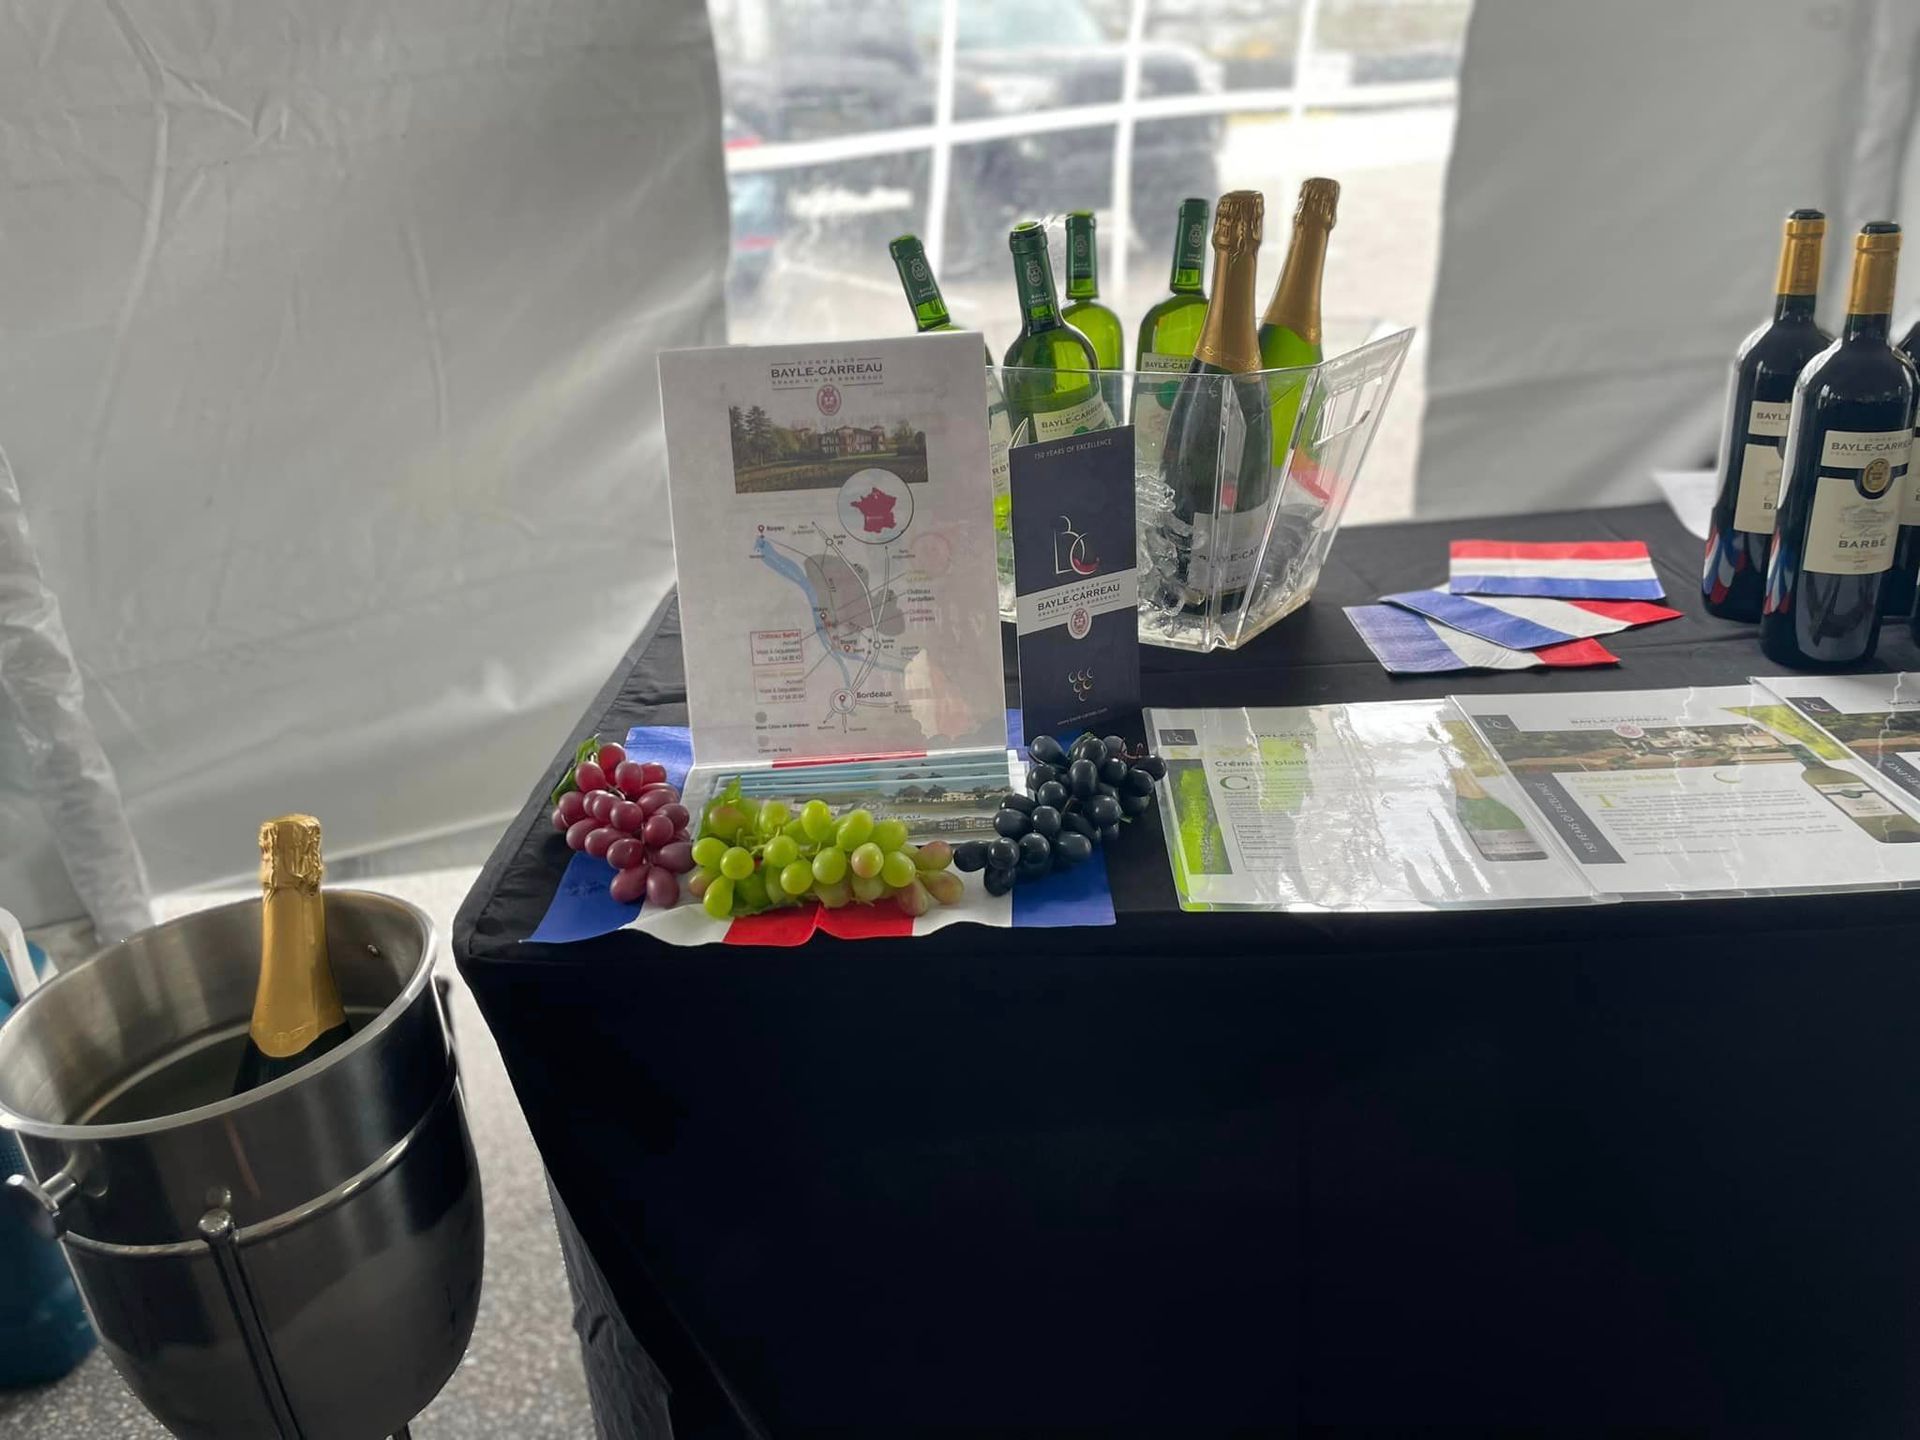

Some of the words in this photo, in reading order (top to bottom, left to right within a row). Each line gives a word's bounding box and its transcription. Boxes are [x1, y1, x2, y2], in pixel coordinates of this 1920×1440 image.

[771, 363, 883, 378] BAYLE-CARREAU
[1037, 583, 1121, 611] BAYLE-CARREAU
[857, 691, 893, 699] Bordeaux
